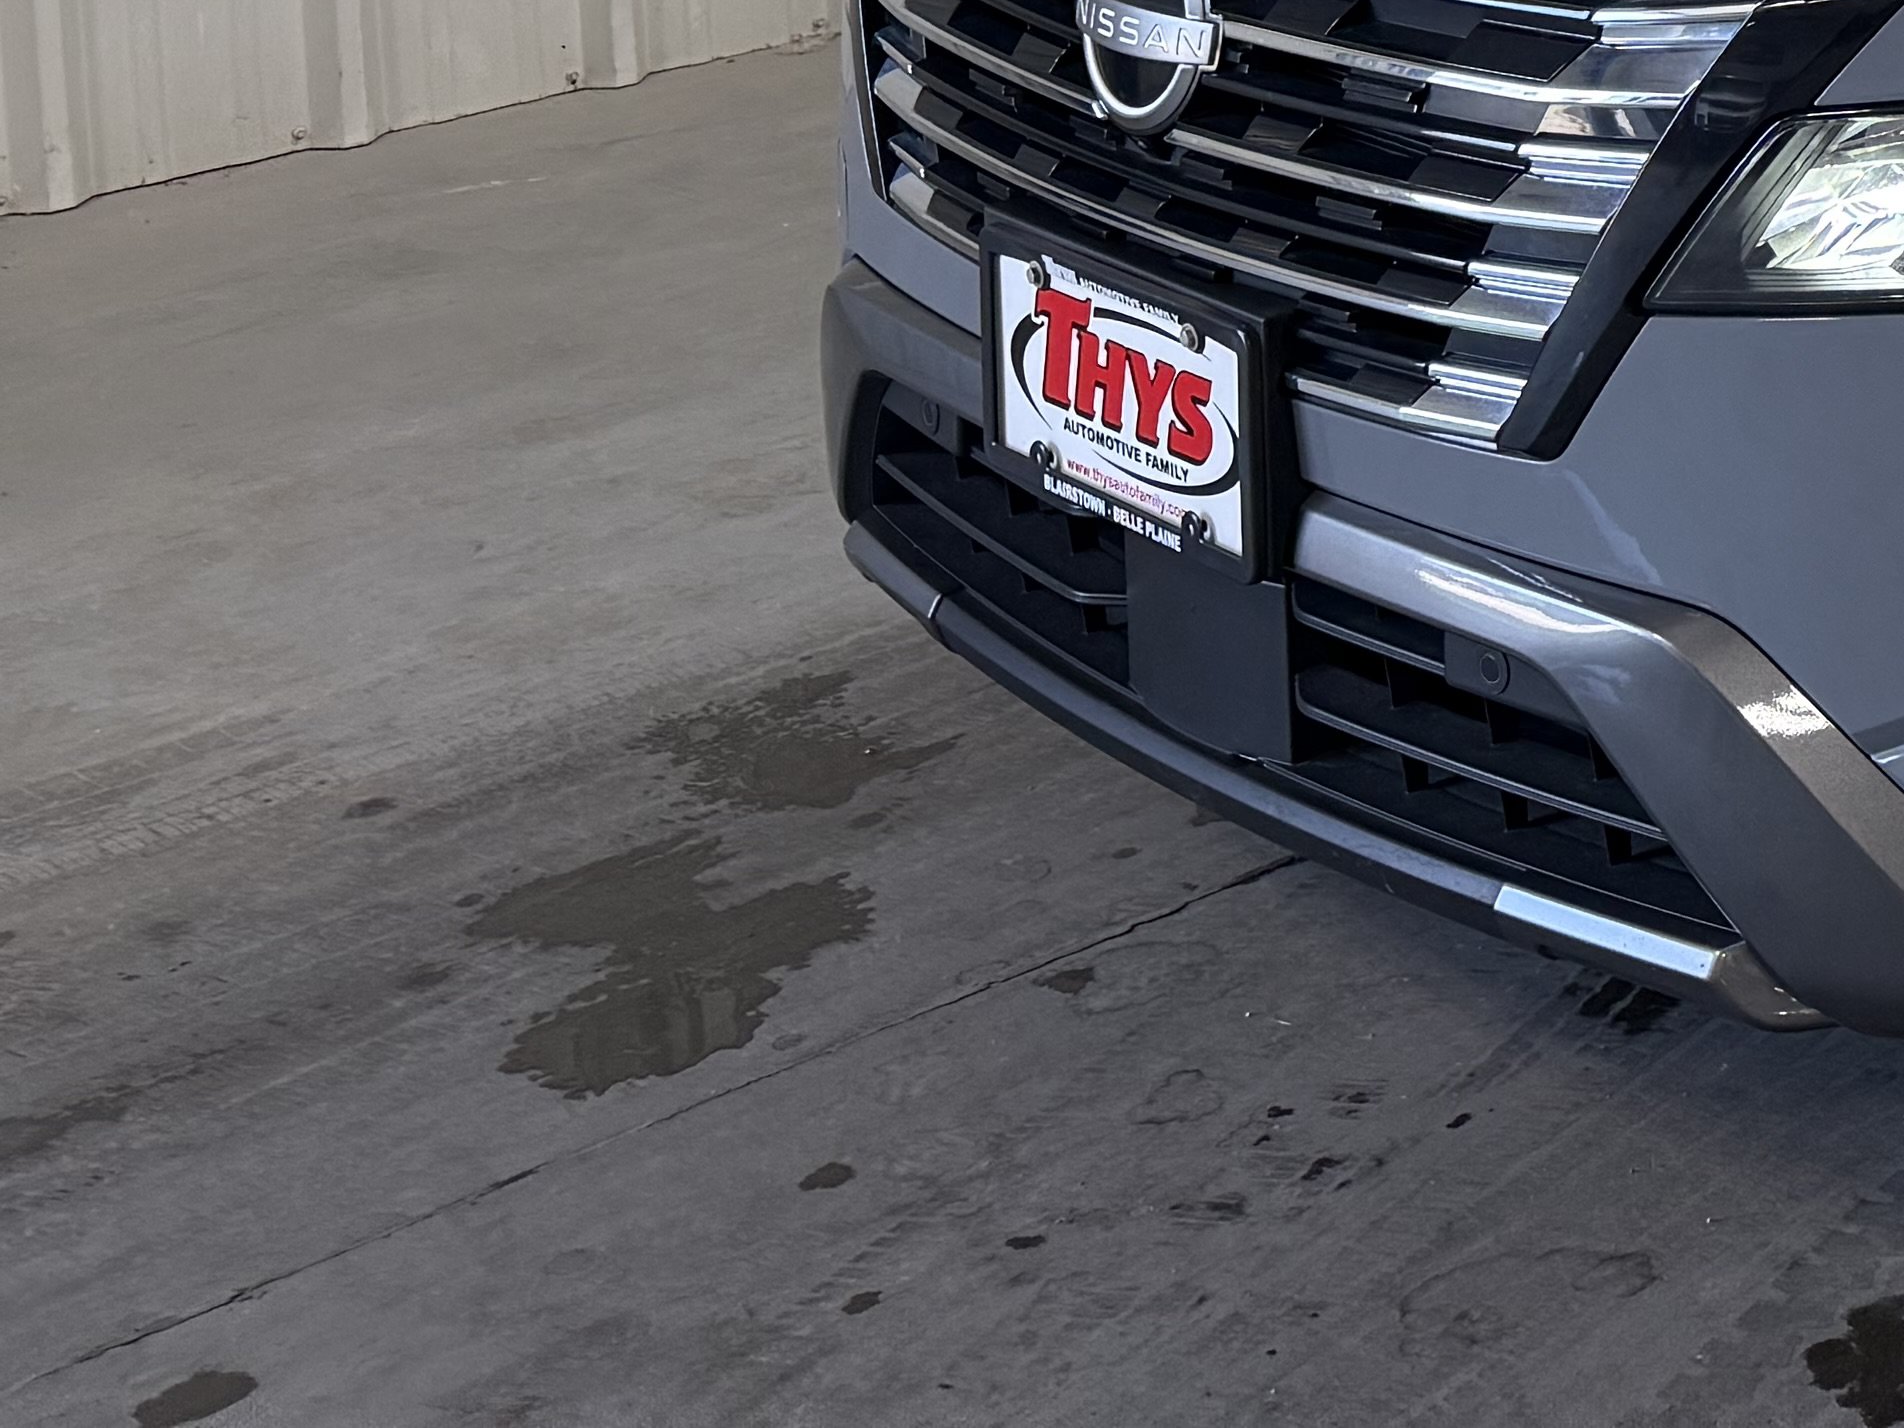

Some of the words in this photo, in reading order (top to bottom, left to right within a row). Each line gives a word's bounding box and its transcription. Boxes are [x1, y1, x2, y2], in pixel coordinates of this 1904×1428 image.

[1035, 288, 1213, 466] THYS
[1063, 417, 1142, 463] AUTOMOTIVE
[1145, 447, 1189, 483] FAMILY
[1043, 474, 1106, 517] BLAIRSTOWN
[1113, 505, 1145, 535] BELLE
[1145, 519, 1182, 553] PLAINE
